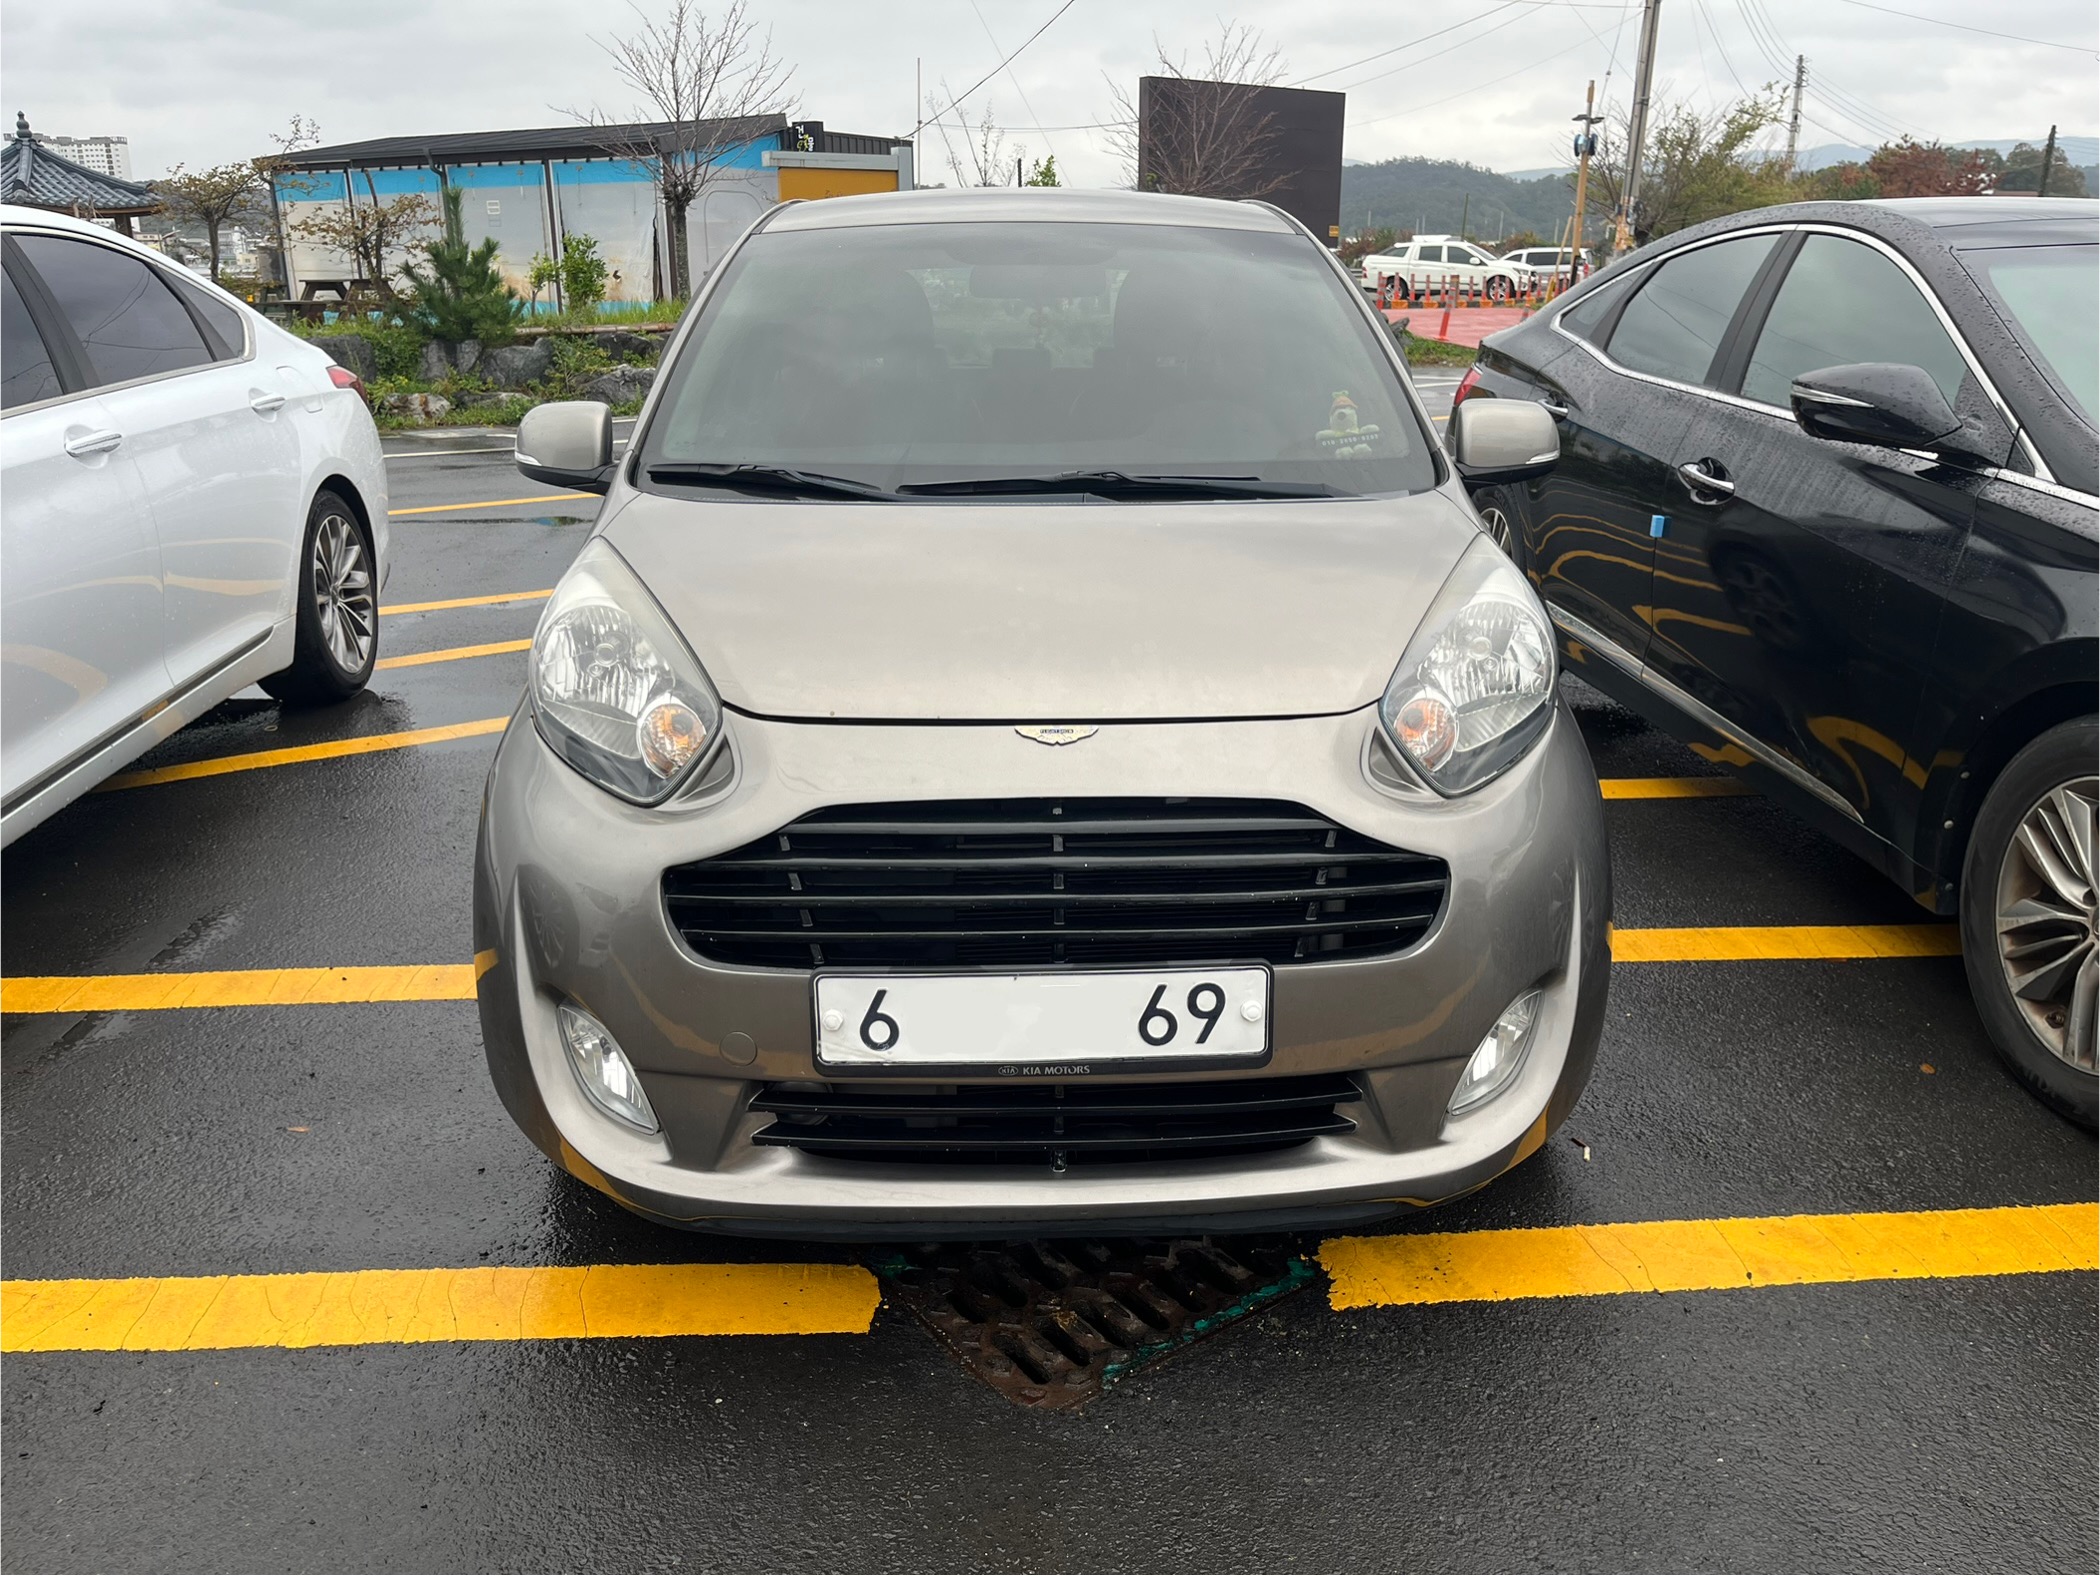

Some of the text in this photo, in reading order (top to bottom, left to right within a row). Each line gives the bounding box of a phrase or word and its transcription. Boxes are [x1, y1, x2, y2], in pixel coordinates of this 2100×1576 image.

[860, 982, 1226, 1051] 6 69
[1023, 1066, 1041, 1075] KIA
[1044, 1065, 1090, 1075] MOTORS
